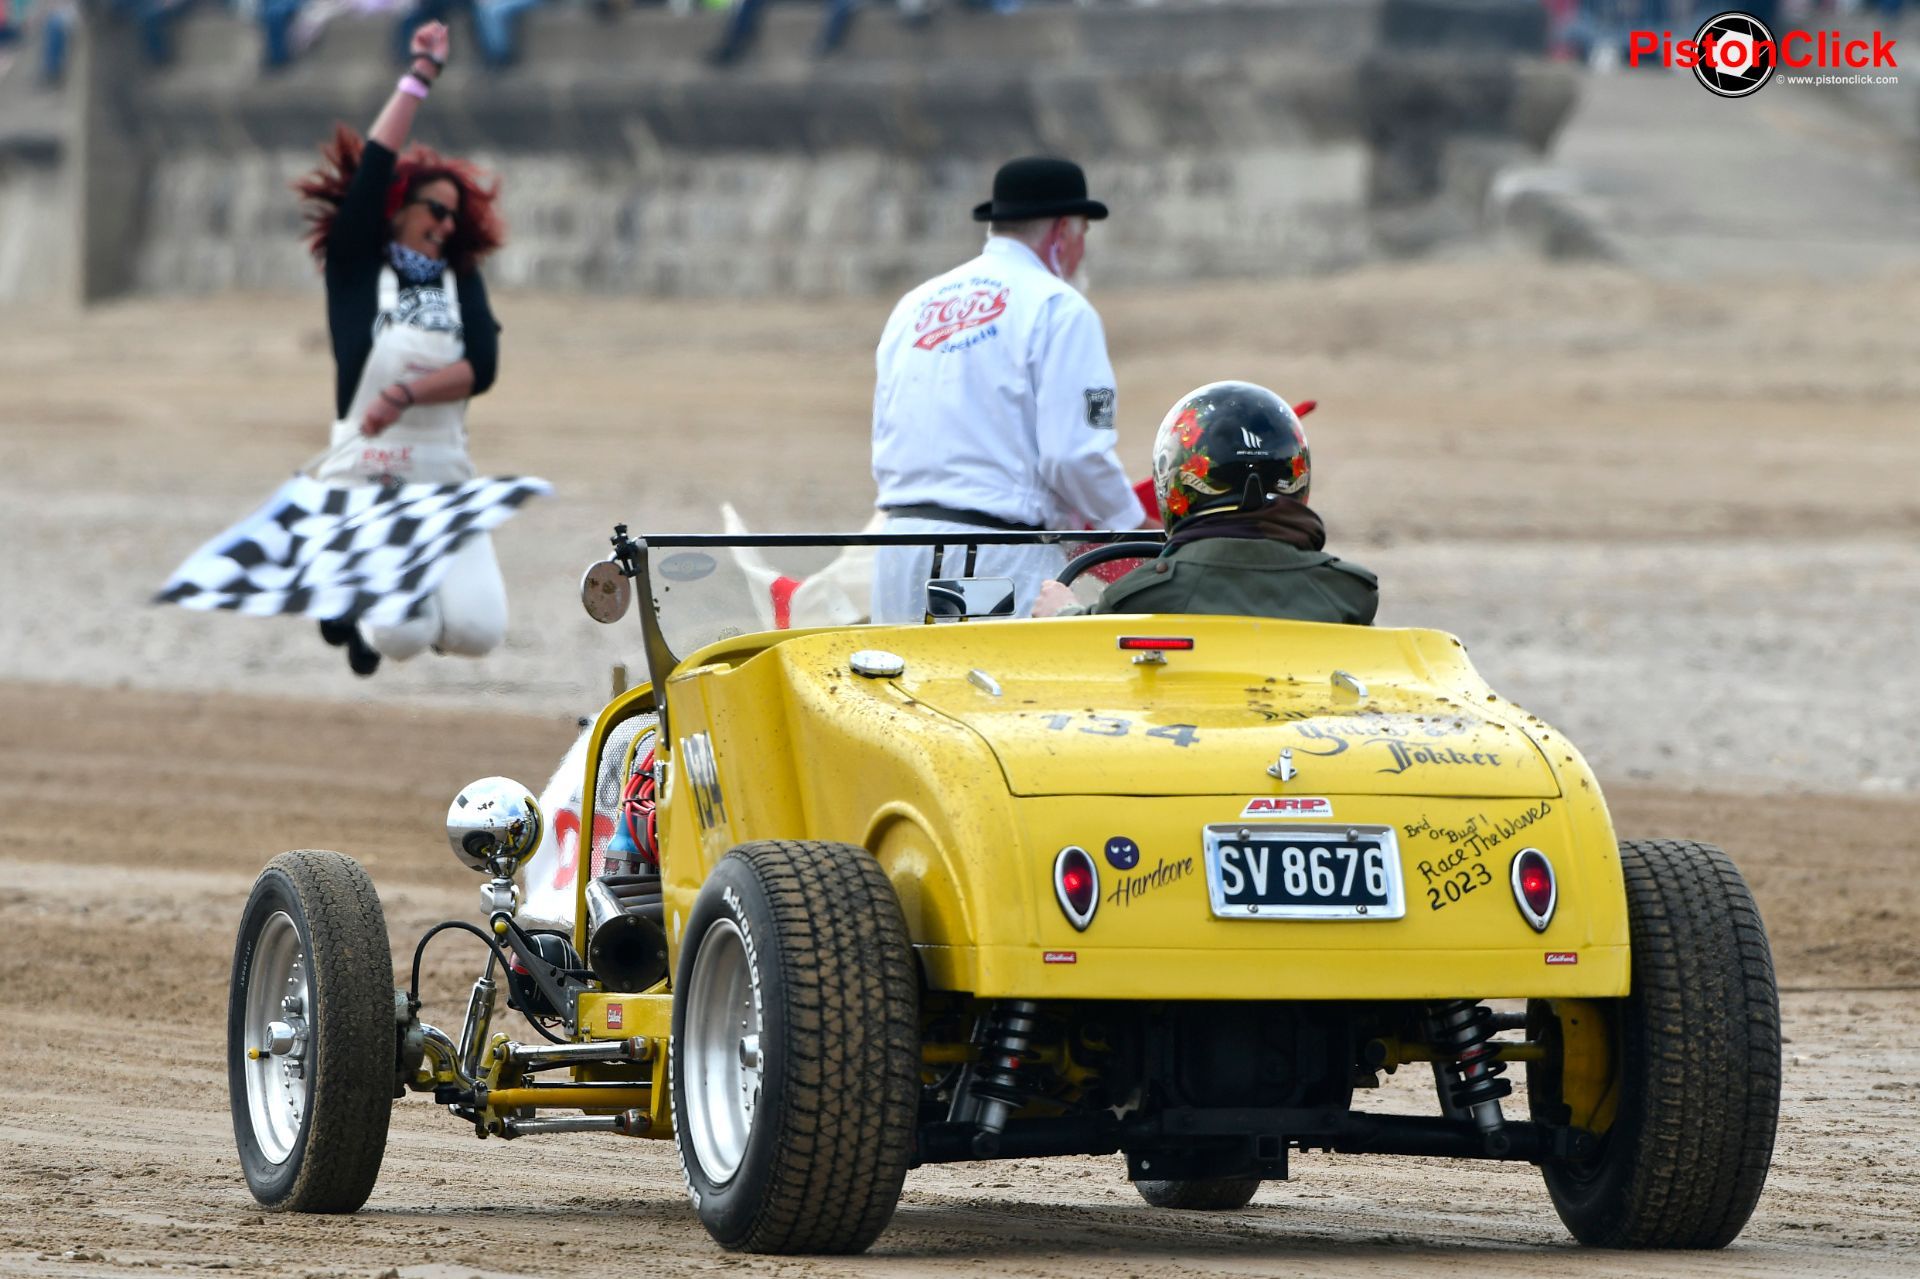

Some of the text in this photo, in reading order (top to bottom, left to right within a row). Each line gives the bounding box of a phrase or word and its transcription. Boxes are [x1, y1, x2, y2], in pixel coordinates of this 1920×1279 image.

[1040, 714, 1200, 747] 134
[1247, 799, 1327, 810] ARP
[1417, 800, 1552, 884] Race The Waves
[1106, 857, 1194, 908] Hardcore
[1218, 845, 1387, 897] SV 8676
[1426, 863, 1492, 911] 2023
